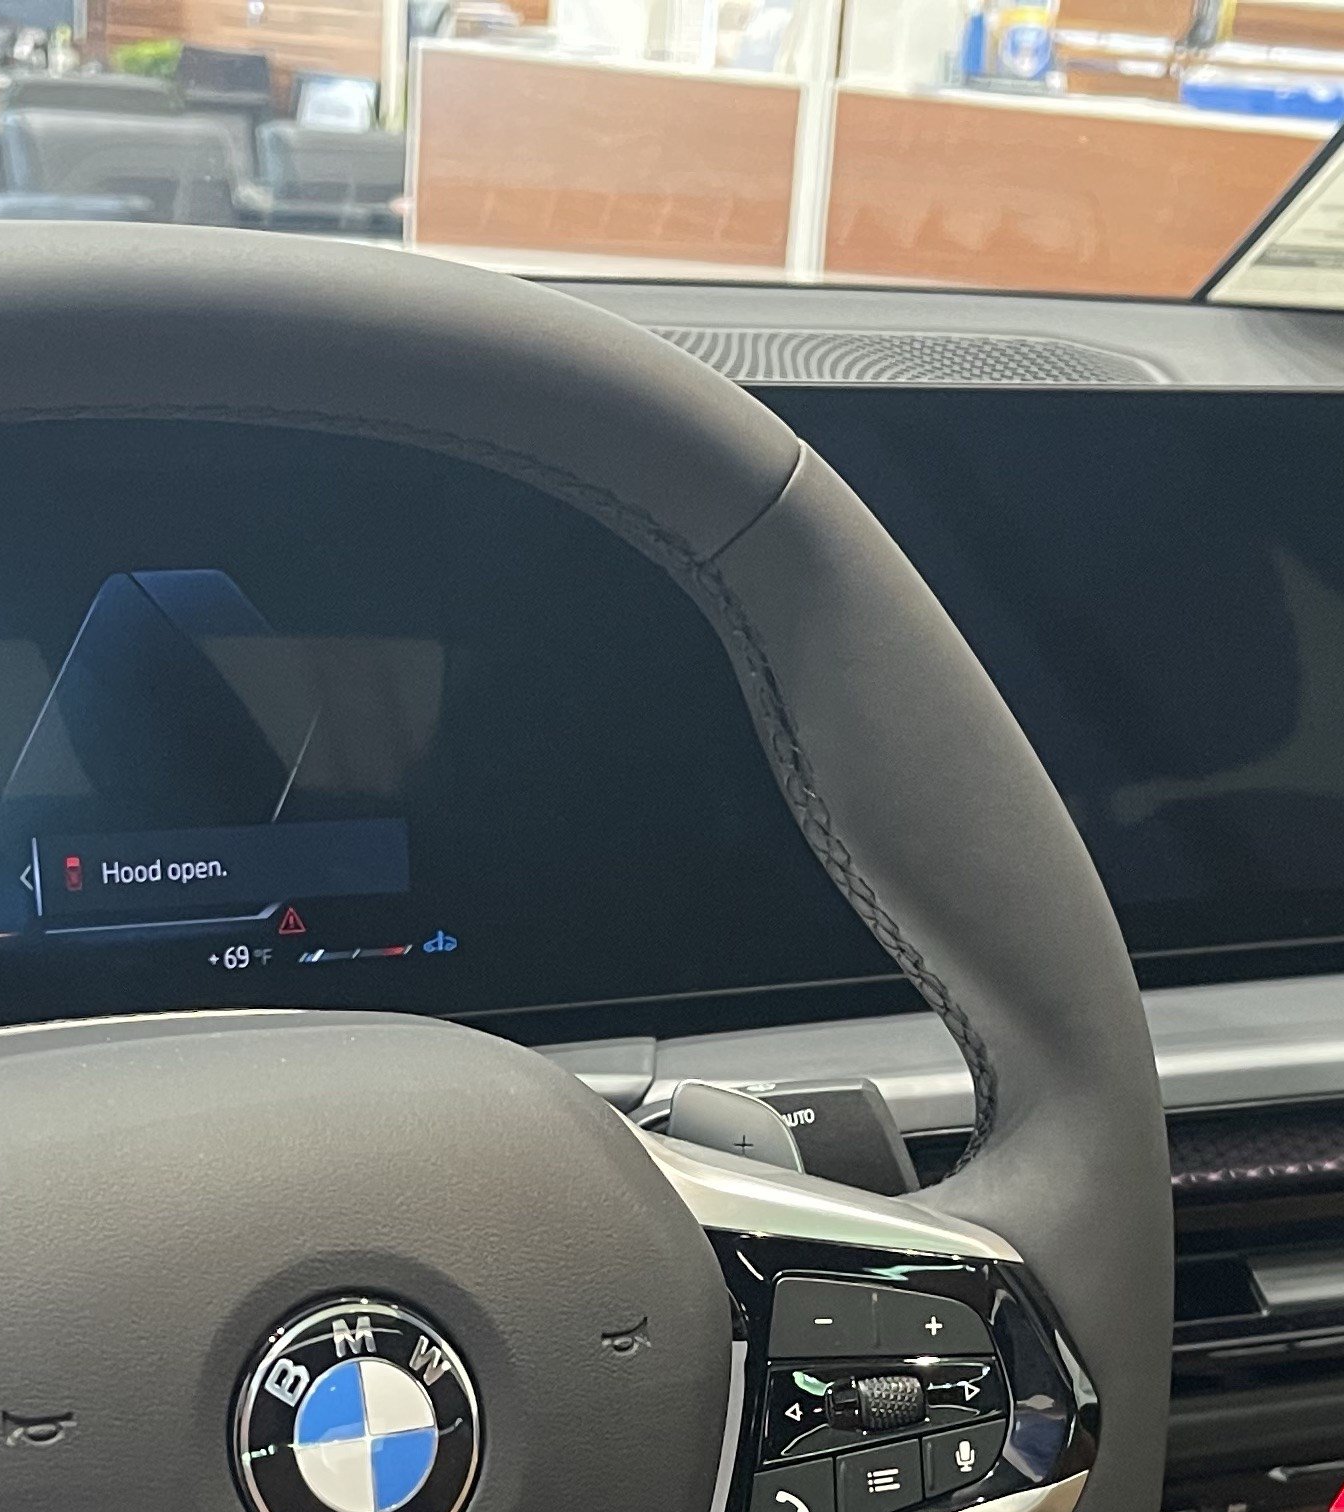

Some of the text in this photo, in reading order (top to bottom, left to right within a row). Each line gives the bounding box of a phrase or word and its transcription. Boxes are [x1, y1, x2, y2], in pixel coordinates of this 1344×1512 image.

[102, 859, 228, 884] Hood open.
[264, 1315, 452, 1407] BMW
